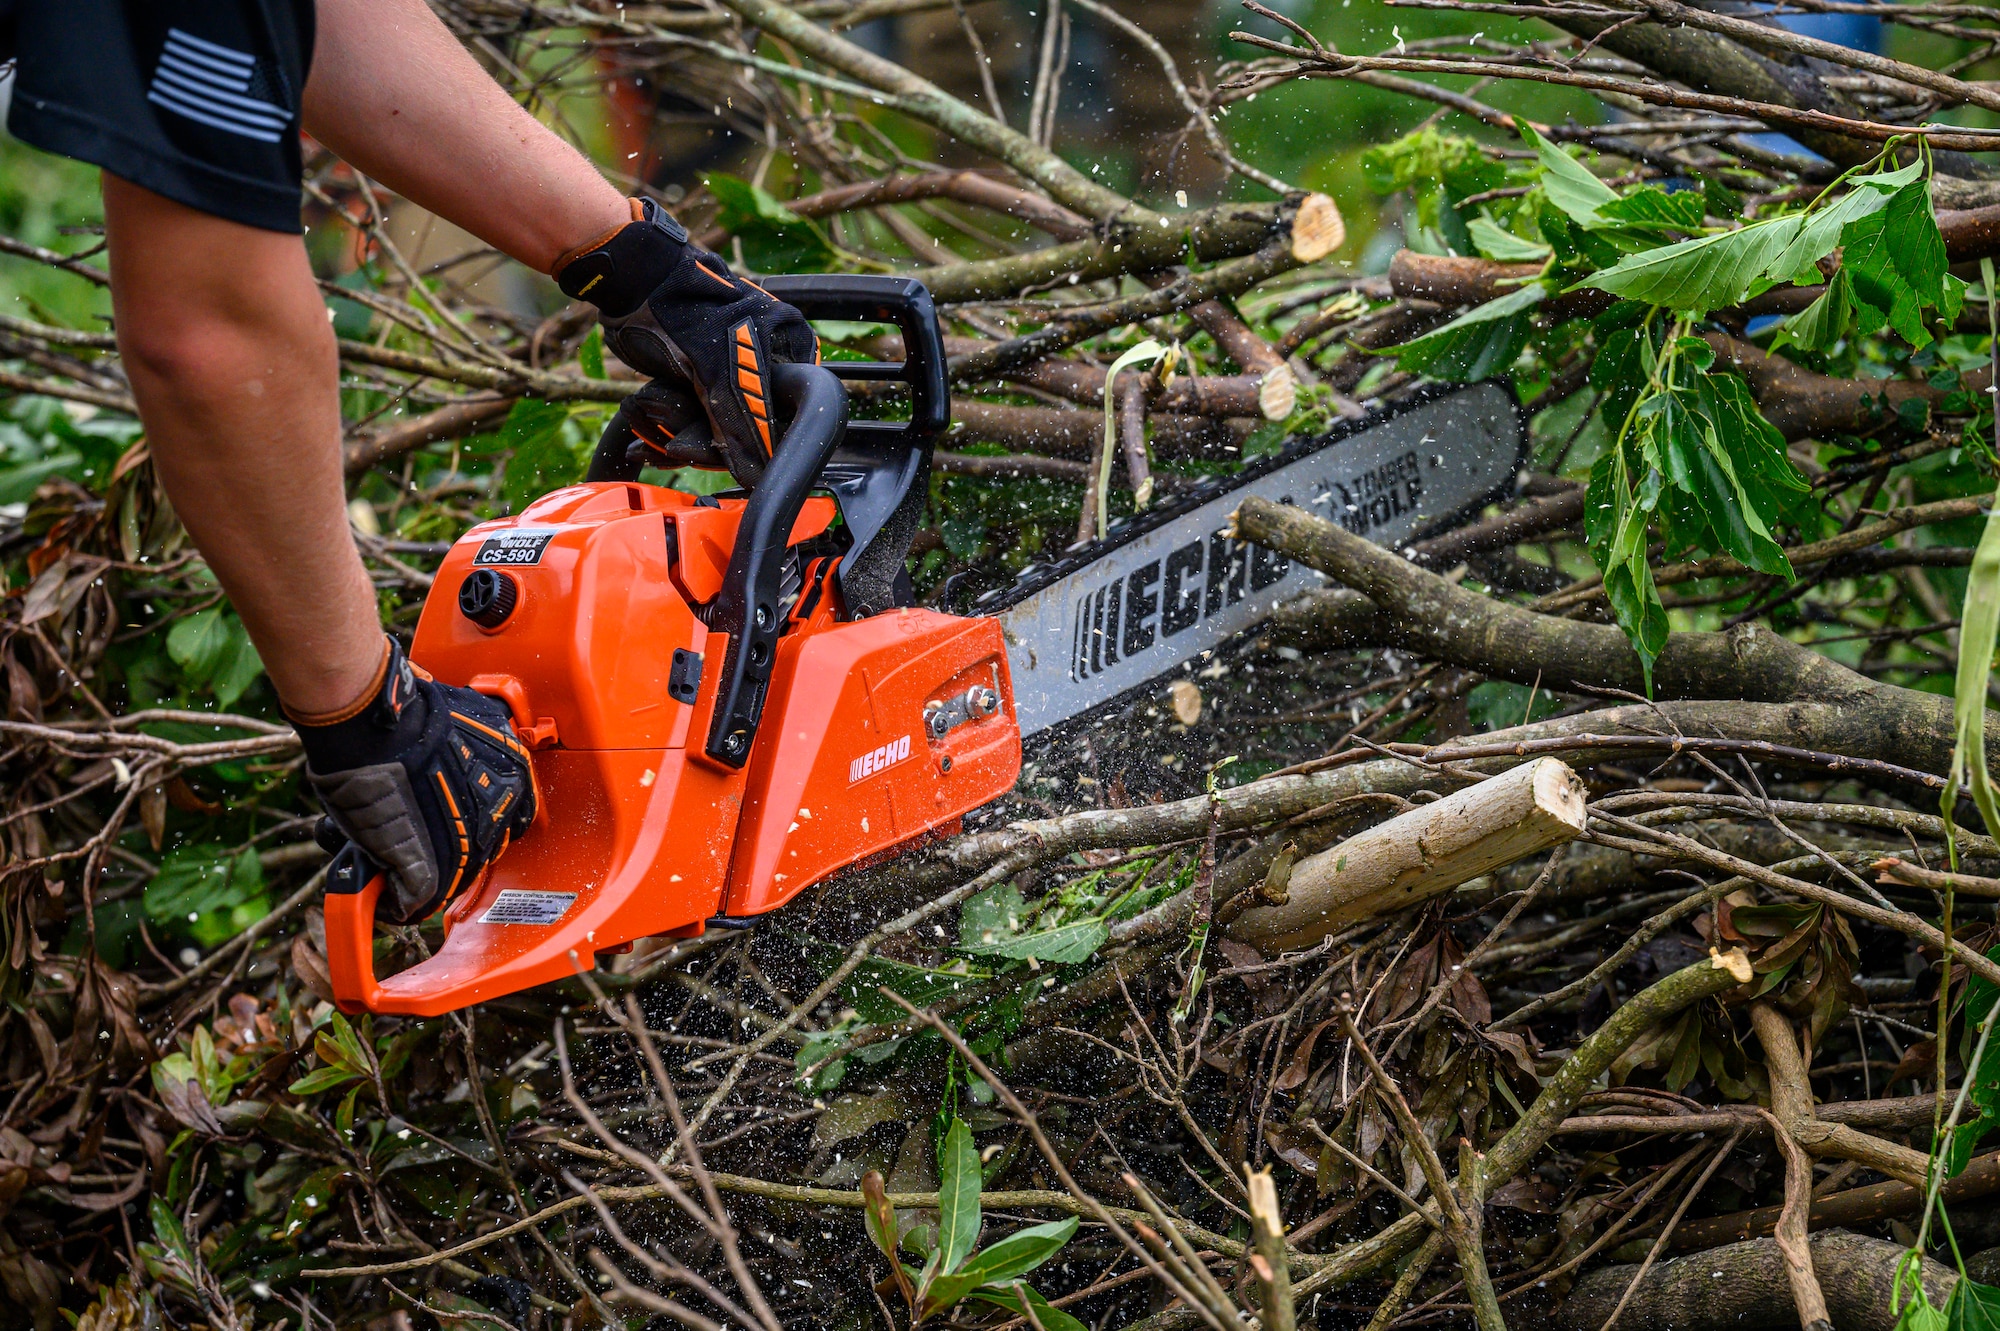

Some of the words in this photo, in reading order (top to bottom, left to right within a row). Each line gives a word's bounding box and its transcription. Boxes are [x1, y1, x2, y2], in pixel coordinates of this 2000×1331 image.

[1352, 451, 1420, 501] TIMBER
[1341, 478, 1422, 535] WOLF
[482, 549, 536, 562] CS-590
[500, 539, 543, 548] WOLF
[861, 734, 911, 777] ECHO
